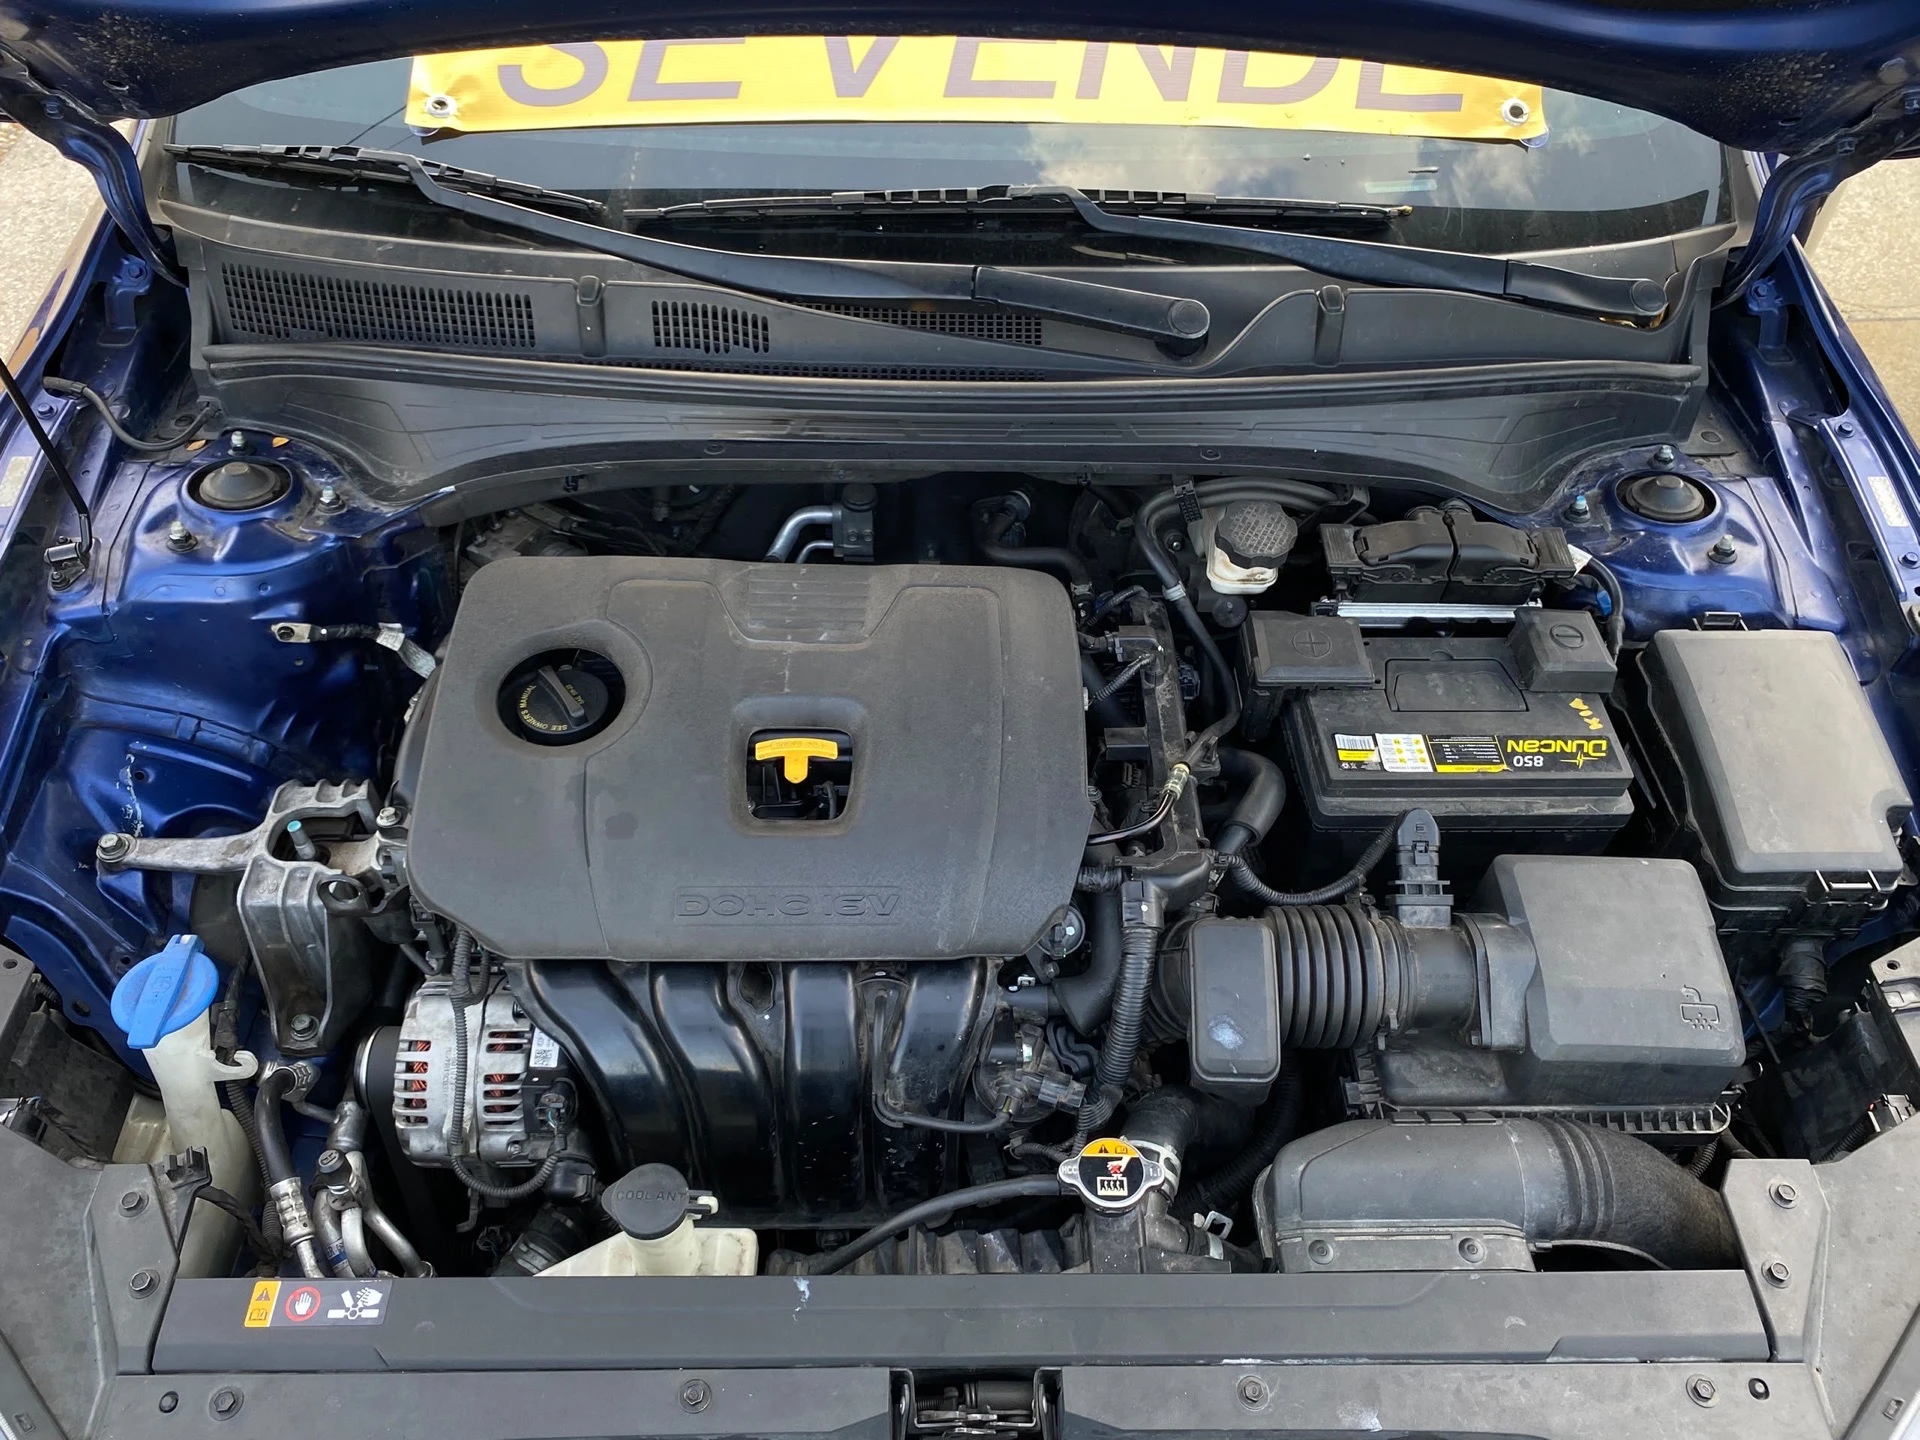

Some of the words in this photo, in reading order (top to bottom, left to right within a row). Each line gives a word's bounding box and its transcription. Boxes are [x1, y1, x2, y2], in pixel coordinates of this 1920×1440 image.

[497, 37, 745, 107] SE
[1513, 755, 1544, 767] 850
[677, 894, 810, 917] DOHC
[824, 894, 901, 917] 16V
[1061, 1165, 1078, 1175] HCC
[616, 1189, 686, 1203] COOLANT
